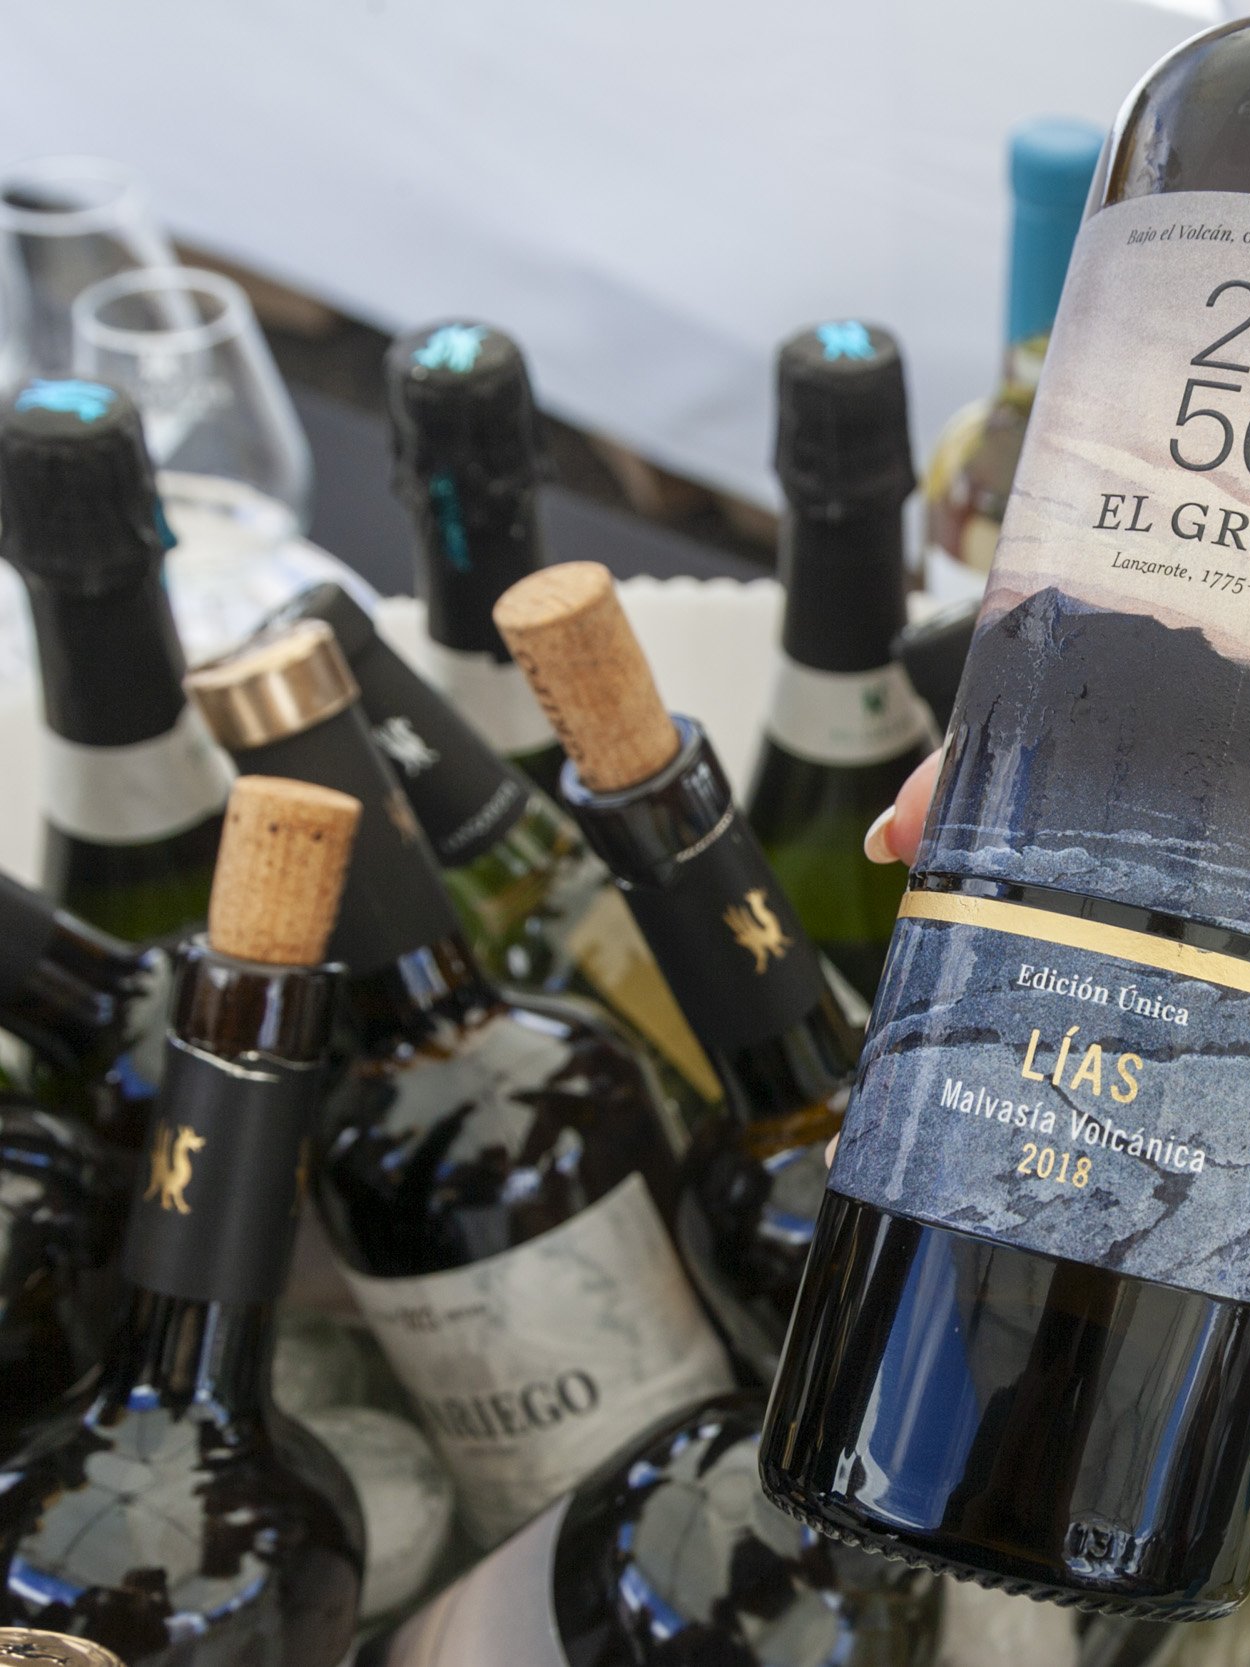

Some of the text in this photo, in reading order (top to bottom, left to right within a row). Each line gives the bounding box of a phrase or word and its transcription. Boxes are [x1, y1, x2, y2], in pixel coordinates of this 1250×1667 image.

[1127, 226, 1157, 246] Bajo
[1160, 224, 1176, 241] el
[1179, 223, 1235, 243] Volcán,
[1092, 493, 1153, 532] EL
[1111, 551, 1193, 582] Lanzarote,
[1016, 963, 1189, 1027] Edición Única
[1021, 1025, 1144, 1104] LÍAS
[940, 1077, 1206, 1173] Malvasía Volcánica
[1016, 1143, 1092, 1188] 2018
